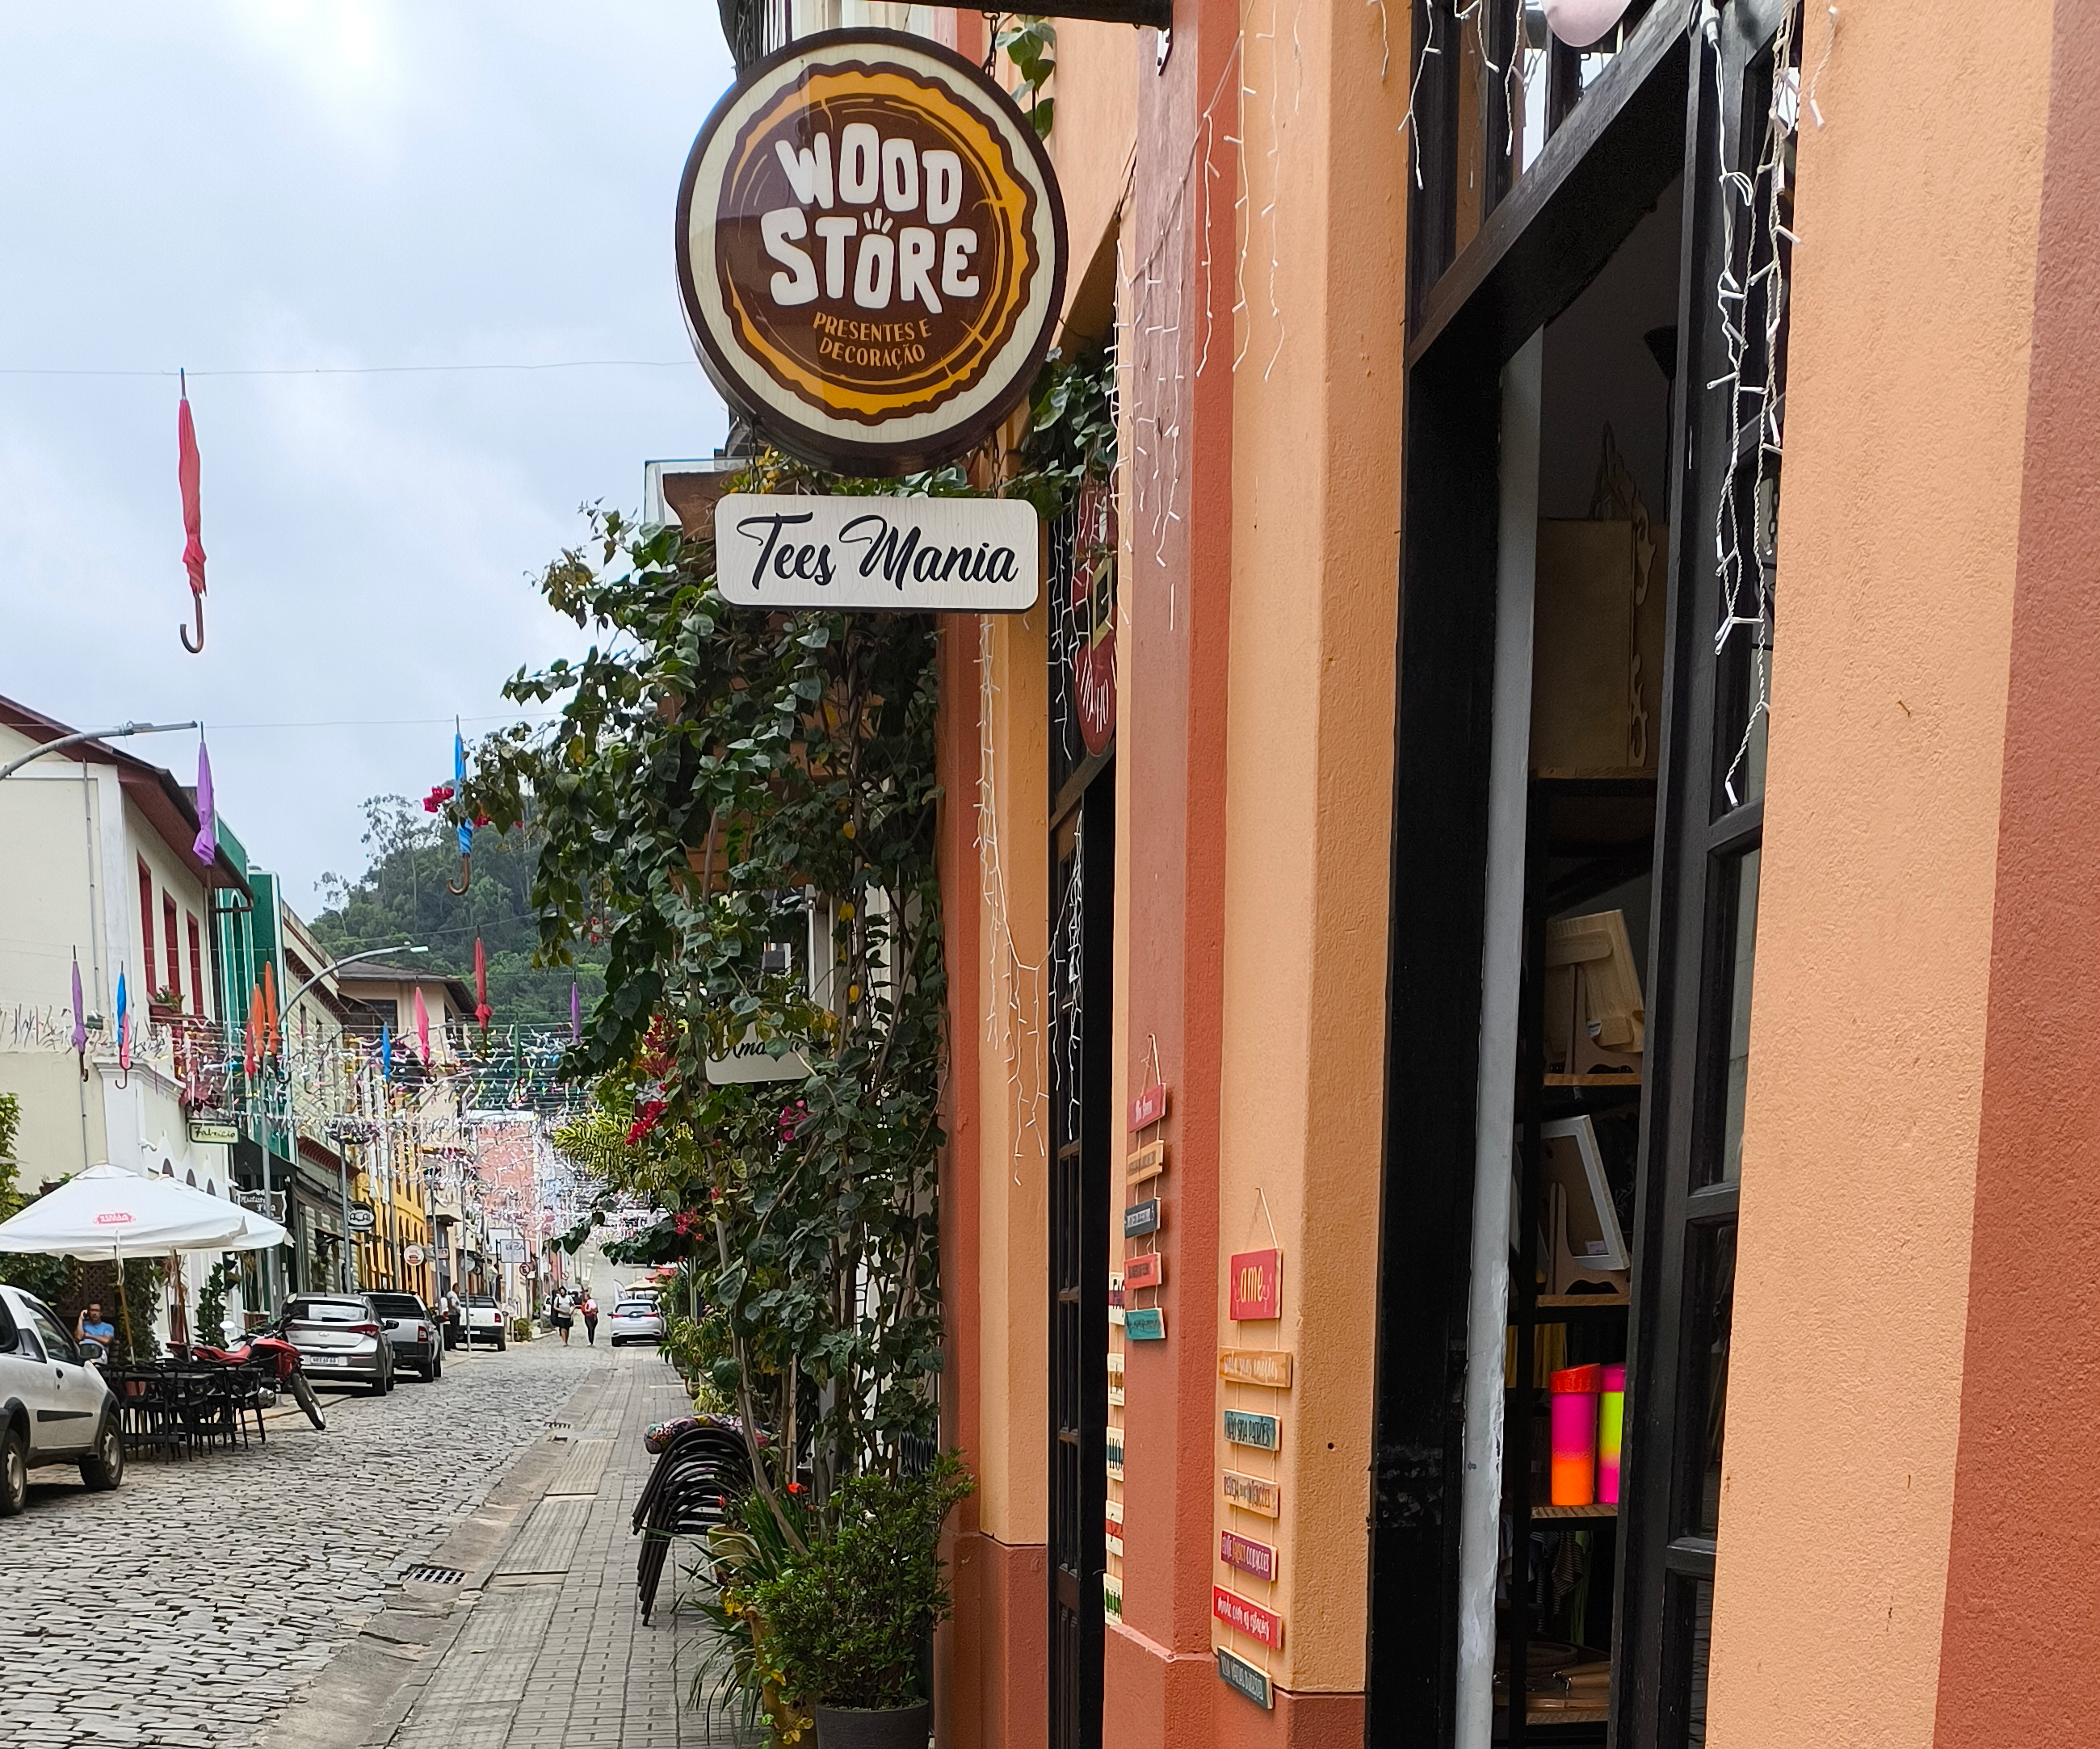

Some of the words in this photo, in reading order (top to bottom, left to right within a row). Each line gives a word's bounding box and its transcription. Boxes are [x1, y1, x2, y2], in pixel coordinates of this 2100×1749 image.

[775, 123, 964, 225] WOOD
[760, 207, 981, 314] STORE
[813, 311, 916, 342] PRESENTES
[919, 316, 933, 338] E
[819, 336, 926, 373] DECORAÇÃO
[736, 512, 837, 591] Tees
[838, 514, 1019, 591] Mania
[1240, 1265, 1264, 1303] ame
